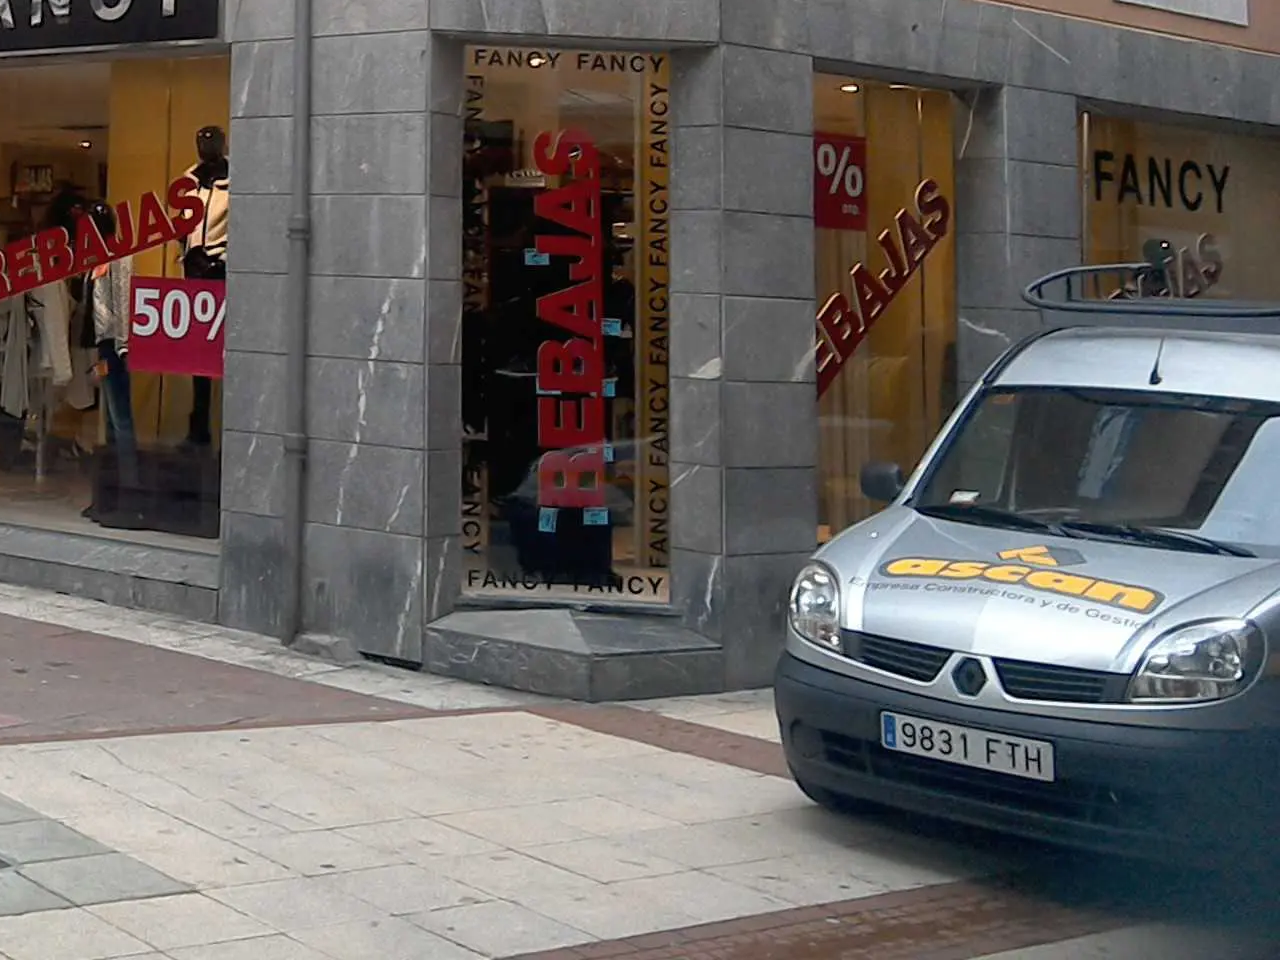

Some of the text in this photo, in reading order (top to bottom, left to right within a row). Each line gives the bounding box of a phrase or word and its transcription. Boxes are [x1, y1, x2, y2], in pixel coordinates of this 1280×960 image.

[474, 49, 665, 73] FANCY FANCY
[650, 83, 669, 168] FANCY
[650, 180, 669, 267] FANCY
[1094, 150, 1230, 214] FANCY
[532, 127, 604, 507] REBAJAS
[650, 280, 669, 366] FANCY
[650, 378, 669, 467] FANCY
[650, 479, 669, 568] FANCY
[849, 576, 920, 591] Empresa
[924, 581, 1036, 605] Constructora
[1057, 600, 1080, 614] de
[883, 557, 1161, 613] ascan
[902, 722, 1042, 774] 9831 FTH
